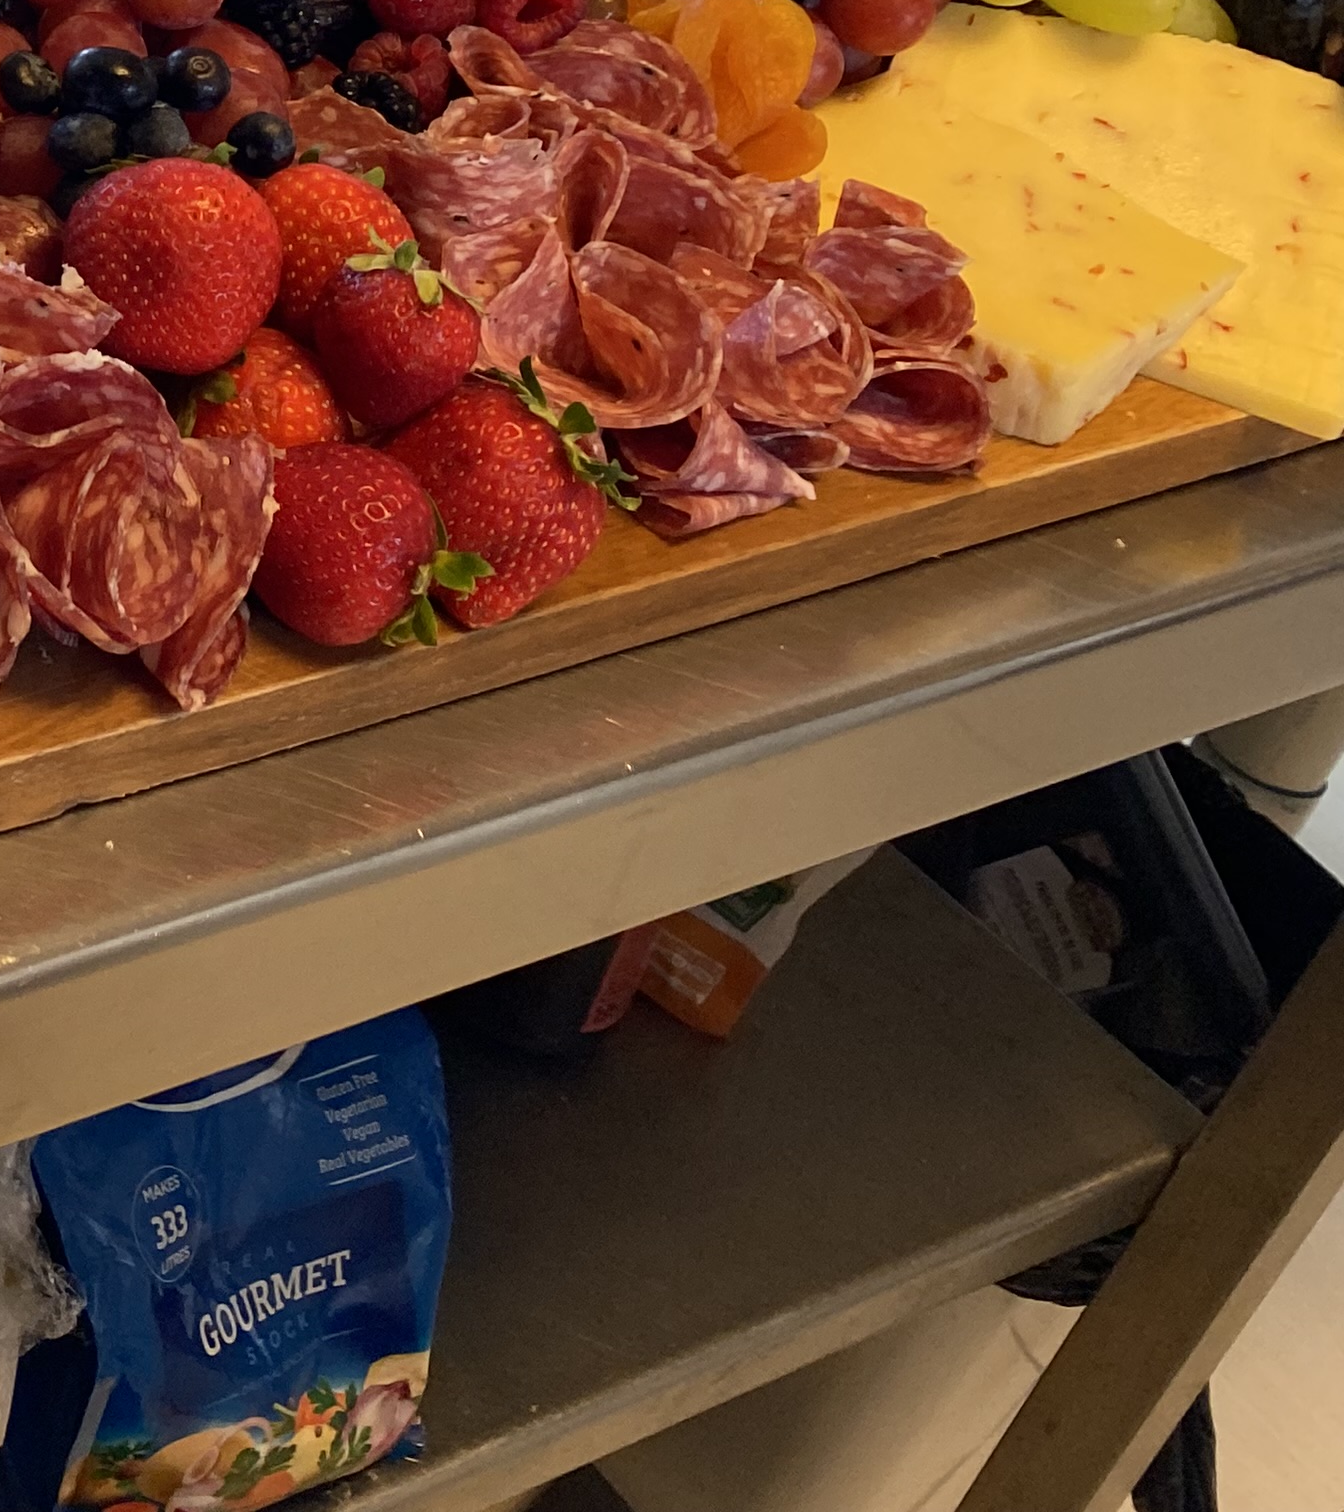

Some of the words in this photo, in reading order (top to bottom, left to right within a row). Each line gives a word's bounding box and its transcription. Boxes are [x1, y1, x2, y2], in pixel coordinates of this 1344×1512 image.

[352, 1072, 379, 1088] Free
[324, 1094, 388, 1123] Vegetarian
[342, 1121, 381, 1141] Vegan
[318, 1152, 347, 1174] Real
[346, 1134, 410, 1164] Vegetables
[142, 1174, 181, 1204] MAKES
[151, 1204, 188, 1250] 333
[161, 1245, 191, 1275] LITRES
[199, 1249, 352, 1357] GOURMET
